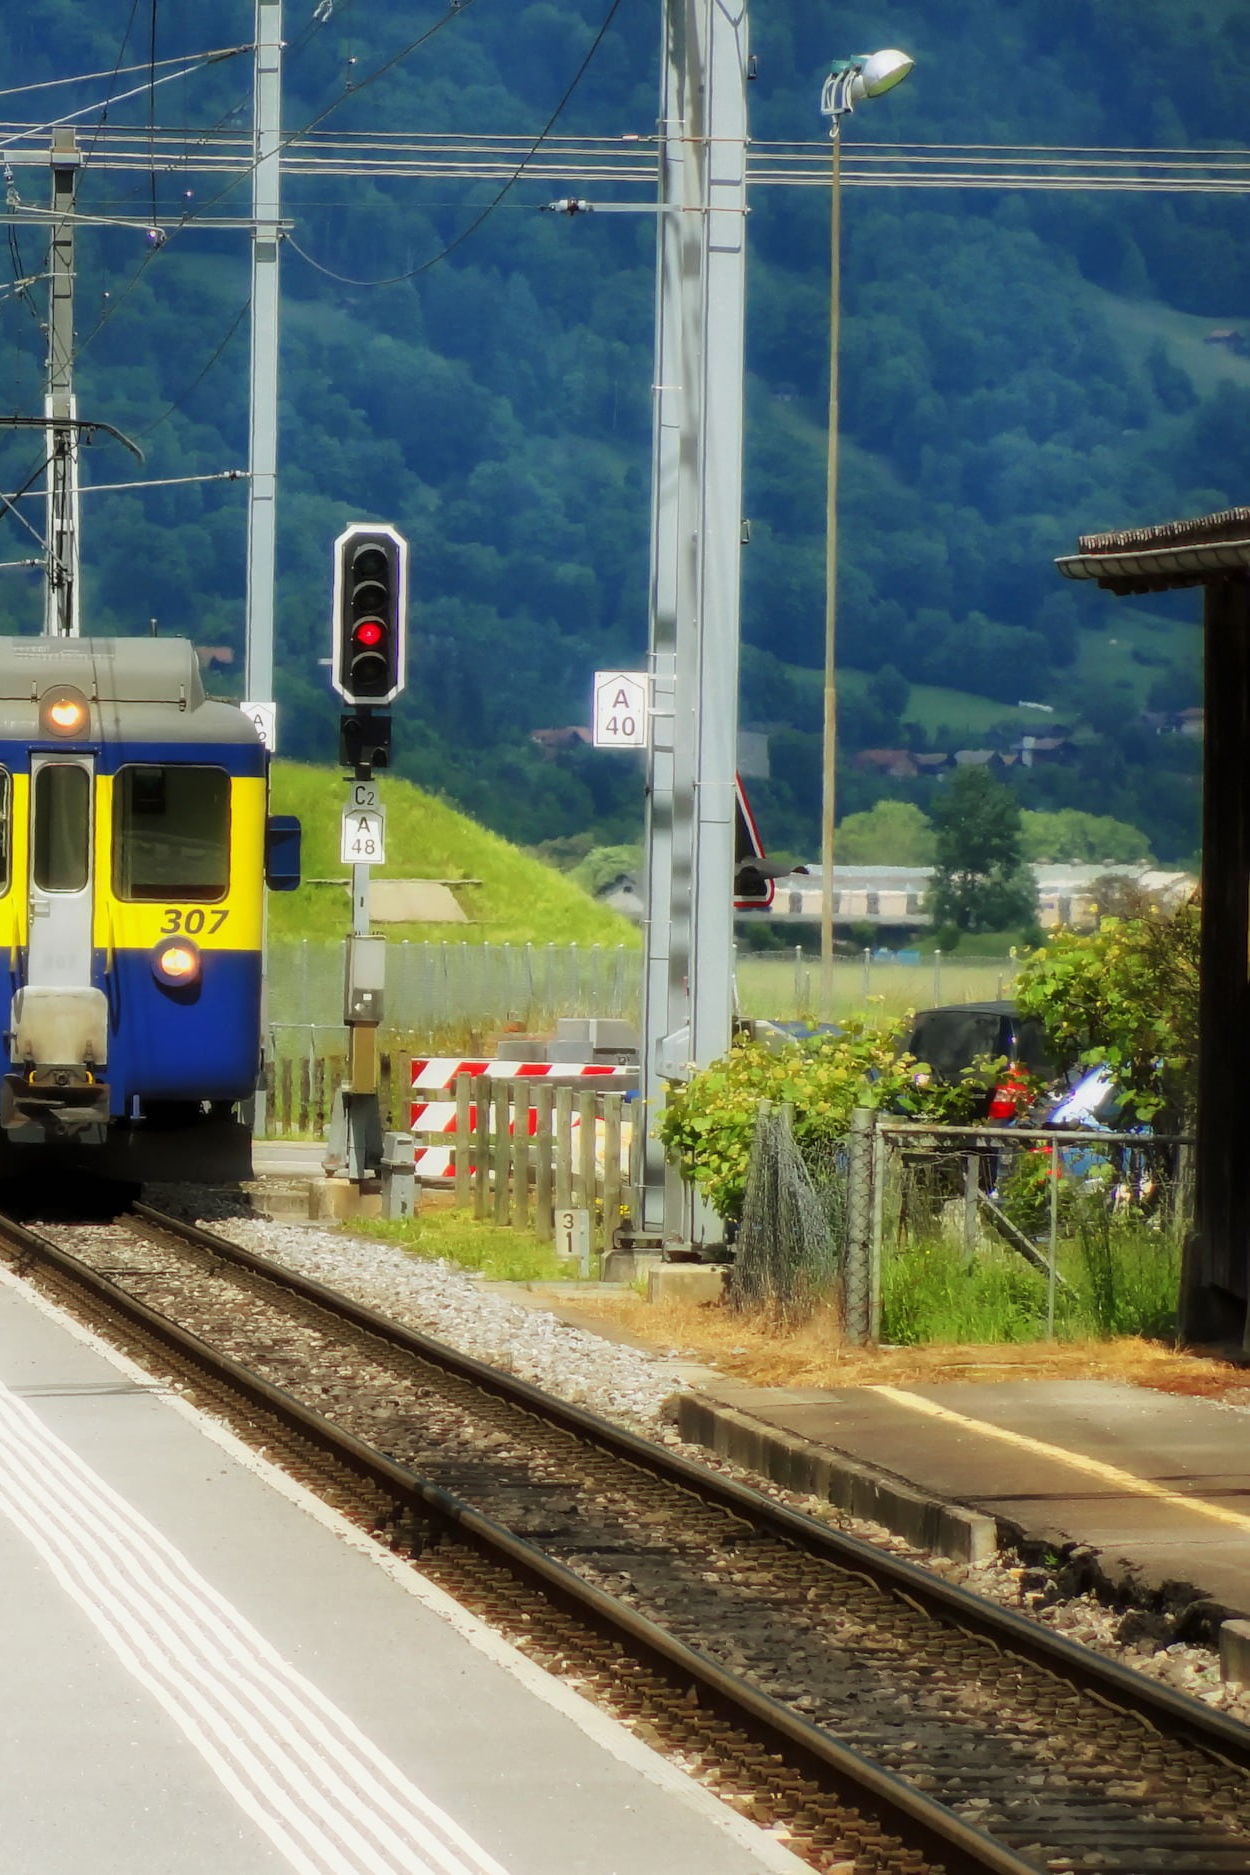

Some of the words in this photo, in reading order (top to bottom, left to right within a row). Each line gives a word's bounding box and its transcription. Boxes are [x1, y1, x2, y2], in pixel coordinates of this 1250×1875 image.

[612, 689, 630, 708] A
[253, 714, 264, 727] A
[605, 716, 636, 736] 40
[355, 785, 375, 806] C2
[357, 816, 370, 832] A
[351, 838, 375, 855] 48
[160, 909, 230, 934] 307
[563, 1213, 574, 1229] 3
[566, 1231, 573, 1253] 1
